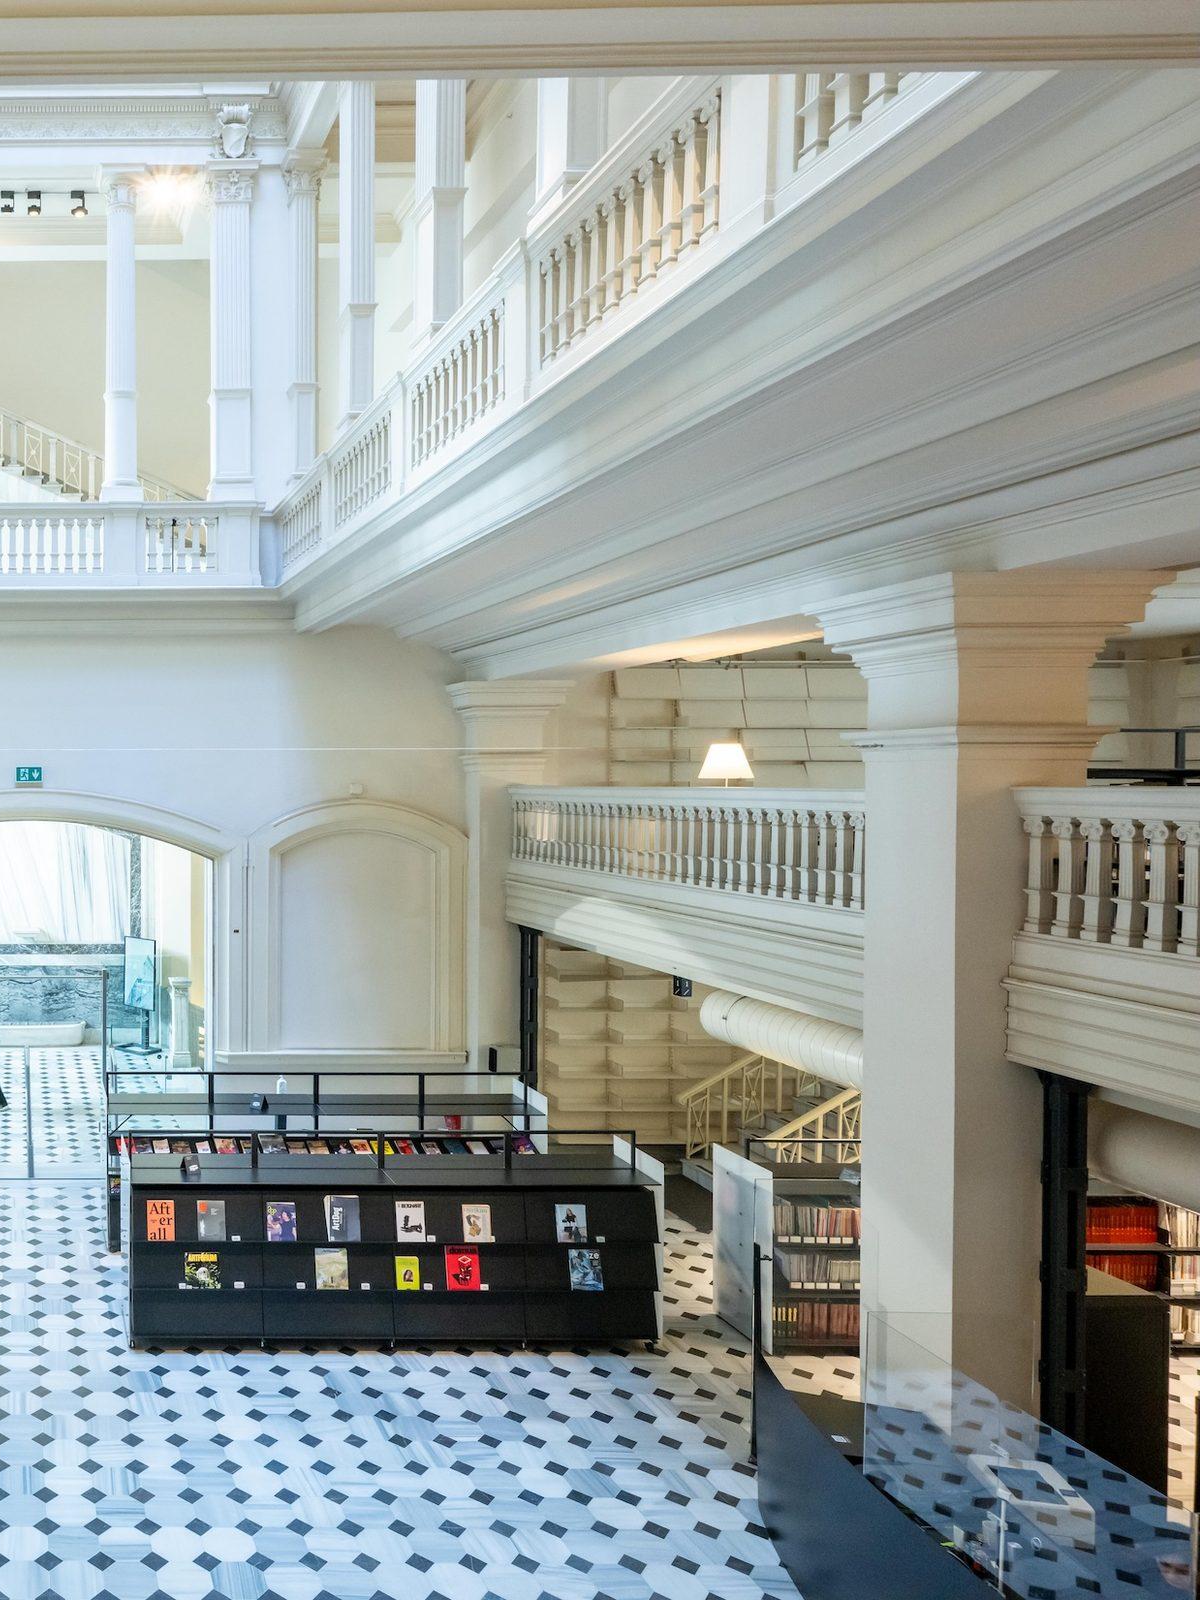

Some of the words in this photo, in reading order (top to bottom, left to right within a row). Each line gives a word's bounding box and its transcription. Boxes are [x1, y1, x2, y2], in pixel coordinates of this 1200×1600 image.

[149, 1202, 170, 1215] Aft
[159, 1217, 173, 1226] er
[149, 1228, 167, 1240] all
